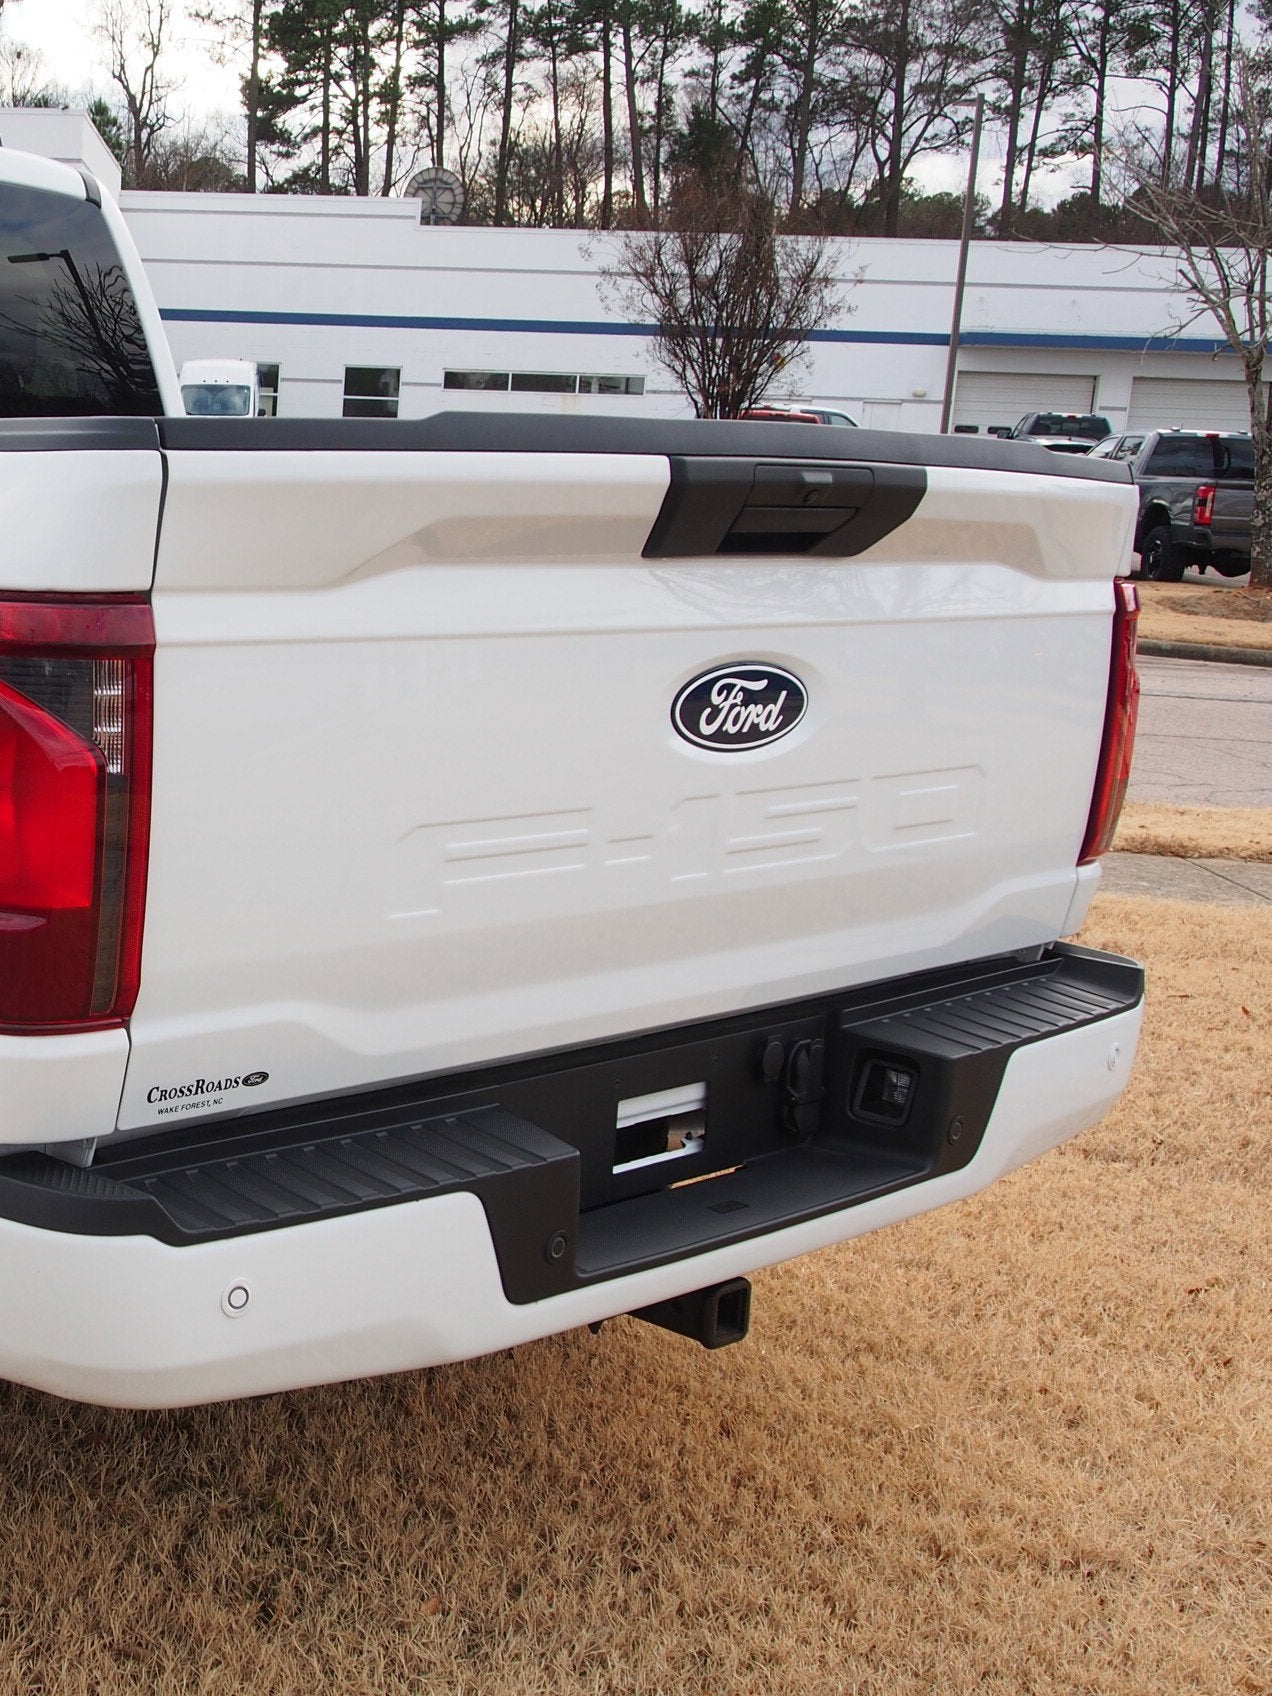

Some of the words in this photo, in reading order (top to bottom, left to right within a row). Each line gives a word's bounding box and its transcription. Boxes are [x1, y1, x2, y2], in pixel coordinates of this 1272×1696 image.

[699, 677, 788, 736] Ford
[157, 1105, 179, 1115] WAKE
[180, 1100, 212, 1111] FOREST,
[212, 1097, 224, 1105] NC
